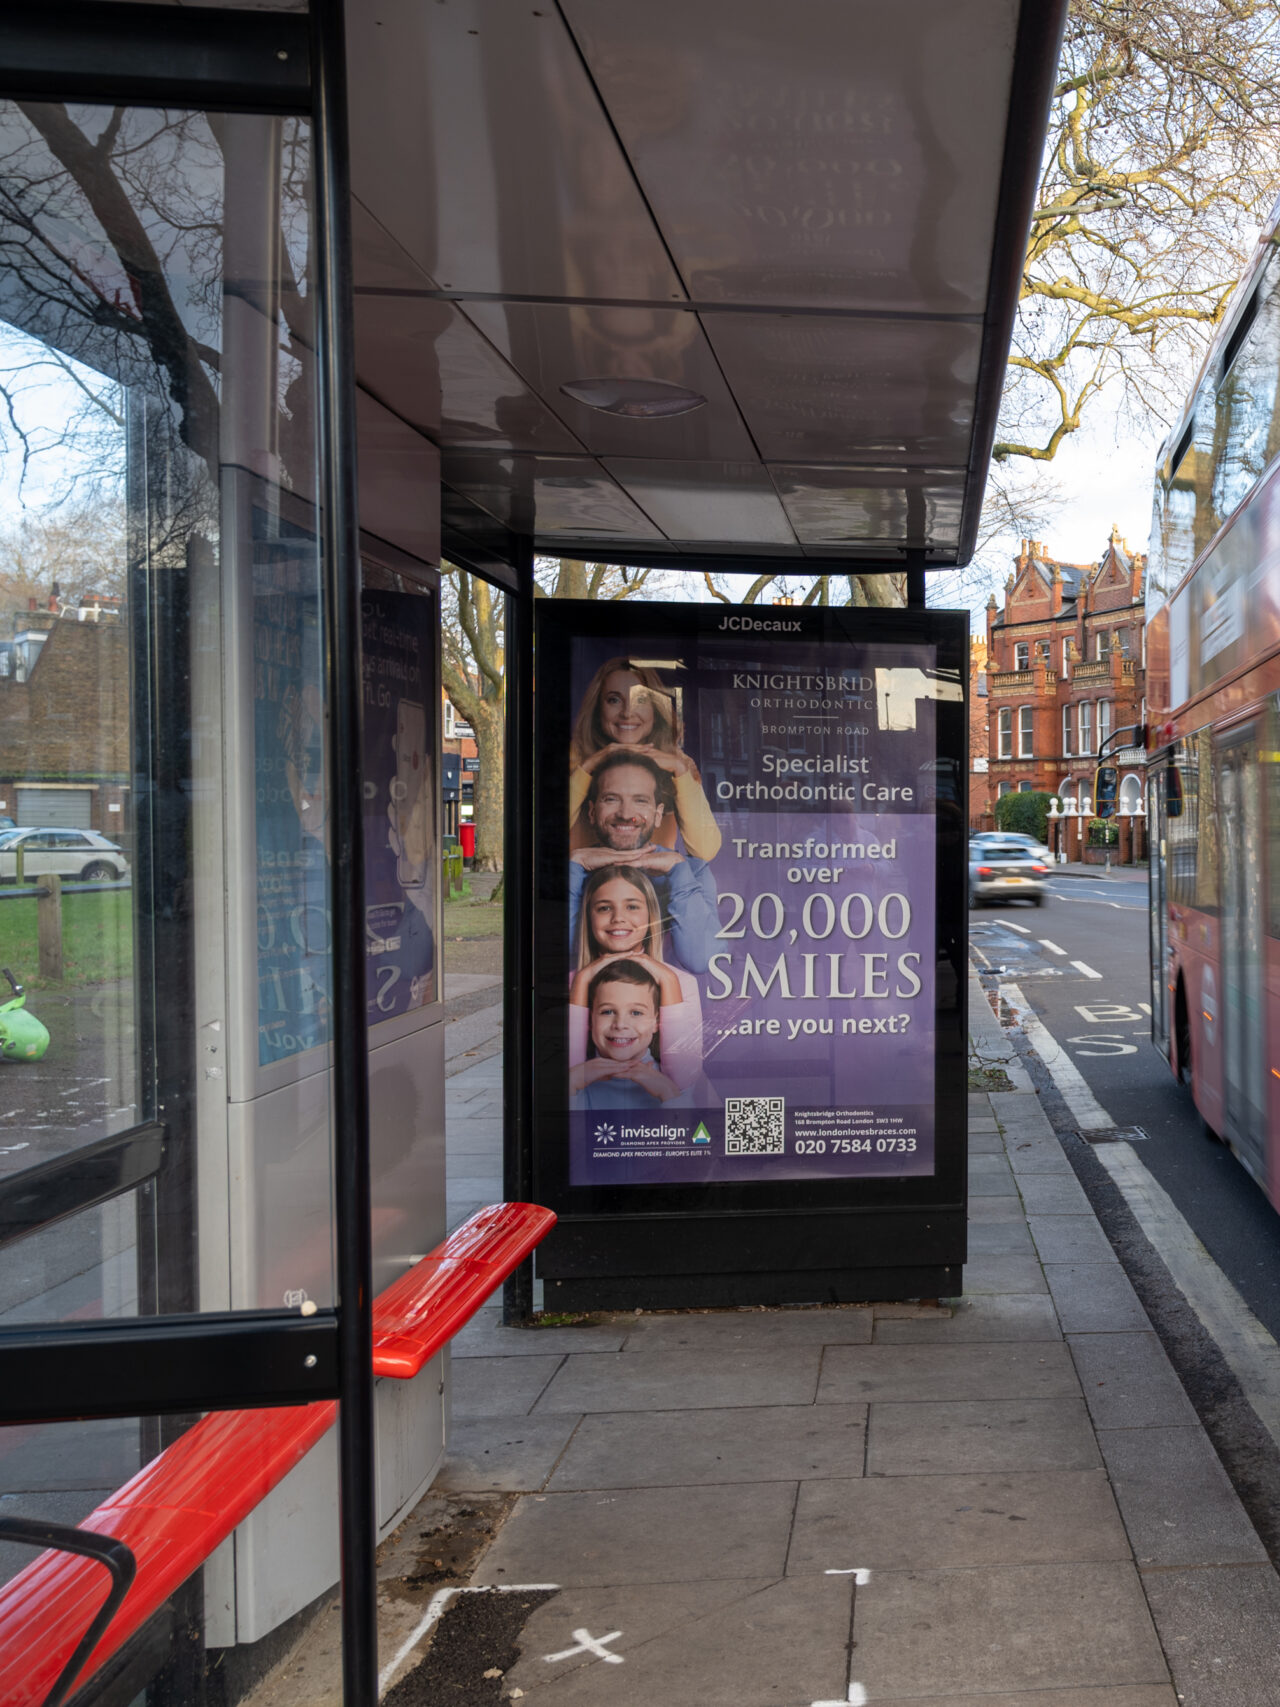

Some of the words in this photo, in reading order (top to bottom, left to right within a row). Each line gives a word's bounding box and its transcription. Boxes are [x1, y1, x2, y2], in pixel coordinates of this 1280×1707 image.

[718, 616, 802, 632] JCDecaux
[732, 674, 895, 692] KNIGHTSBRID
[377, 683, 392, 709] Go
[762, 725, 831, 735] BROMPTON
[837, 726, 870, 736] ROAD
[762, 754, 869, 778] Specialist
[716, 781, 855, 801] Orthodontic
[862, 783, 914, 801] Care
[732, 838, 897, 859] Transformed
[787, 867, 844, 883] over
[714, 892, 912, 945] 20,000
[706, 952, 922, 1000] SMILES
[716, 1018, 780, 1035] ...are
[788, 1018, 833, 1040] you
[842, 1013, 911, 1035] next?
[620, 1125, 686, 1141] invisalign
[794, 1127, 917, 1137] www.londonlovesbraces.com
[795, 1140, 826, 1154] 020
[830, 1139, 872, 1153] 7584
[876, 1138, 917, 1153] 0733
